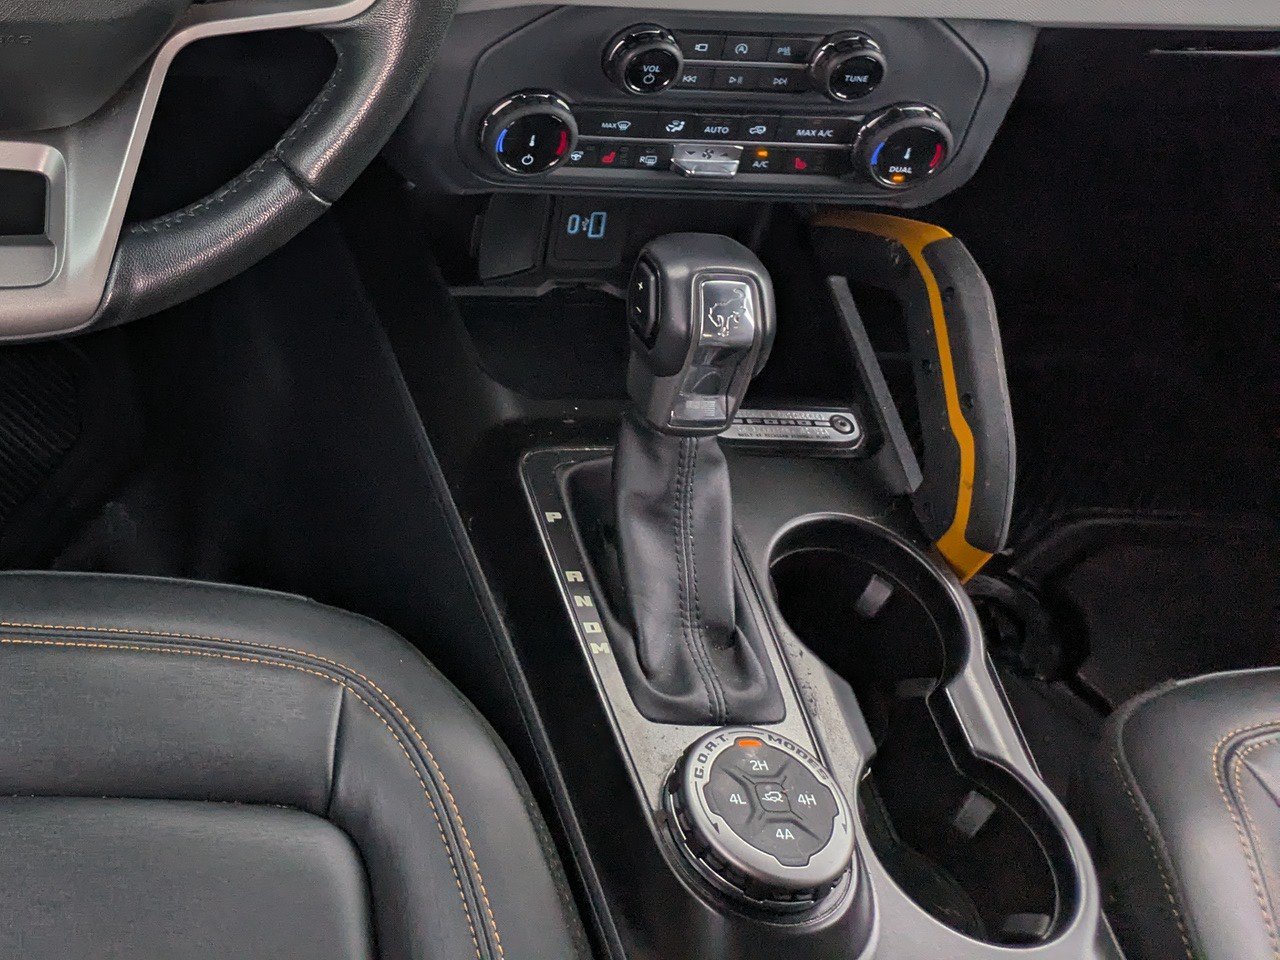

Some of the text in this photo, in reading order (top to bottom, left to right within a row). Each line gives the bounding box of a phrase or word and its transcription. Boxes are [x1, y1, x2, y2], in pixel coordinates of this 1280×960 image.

[643, 65, 661, 73] VOL
[845, 75, 869, 83] TUNE
[704, 126, 730, 134] AUTO
[796, 129, 834, 138] MAX A/C
[752, 160, 769, 168] A/C
[889, 166, 913, 175] DUAL
[545, 511, 562, 523] P
[574, 595, 593, 607] N
[582, 621, 602, 633] D
[590, 642, 610, 654] M
[767, 734, 829, 780] MODES
[749, 760, 769, 771] 2H
[729, 793, 747, 805] 4L
[797, 793, 817, 806] 4H
[775, 828, 795, 840] 4A
